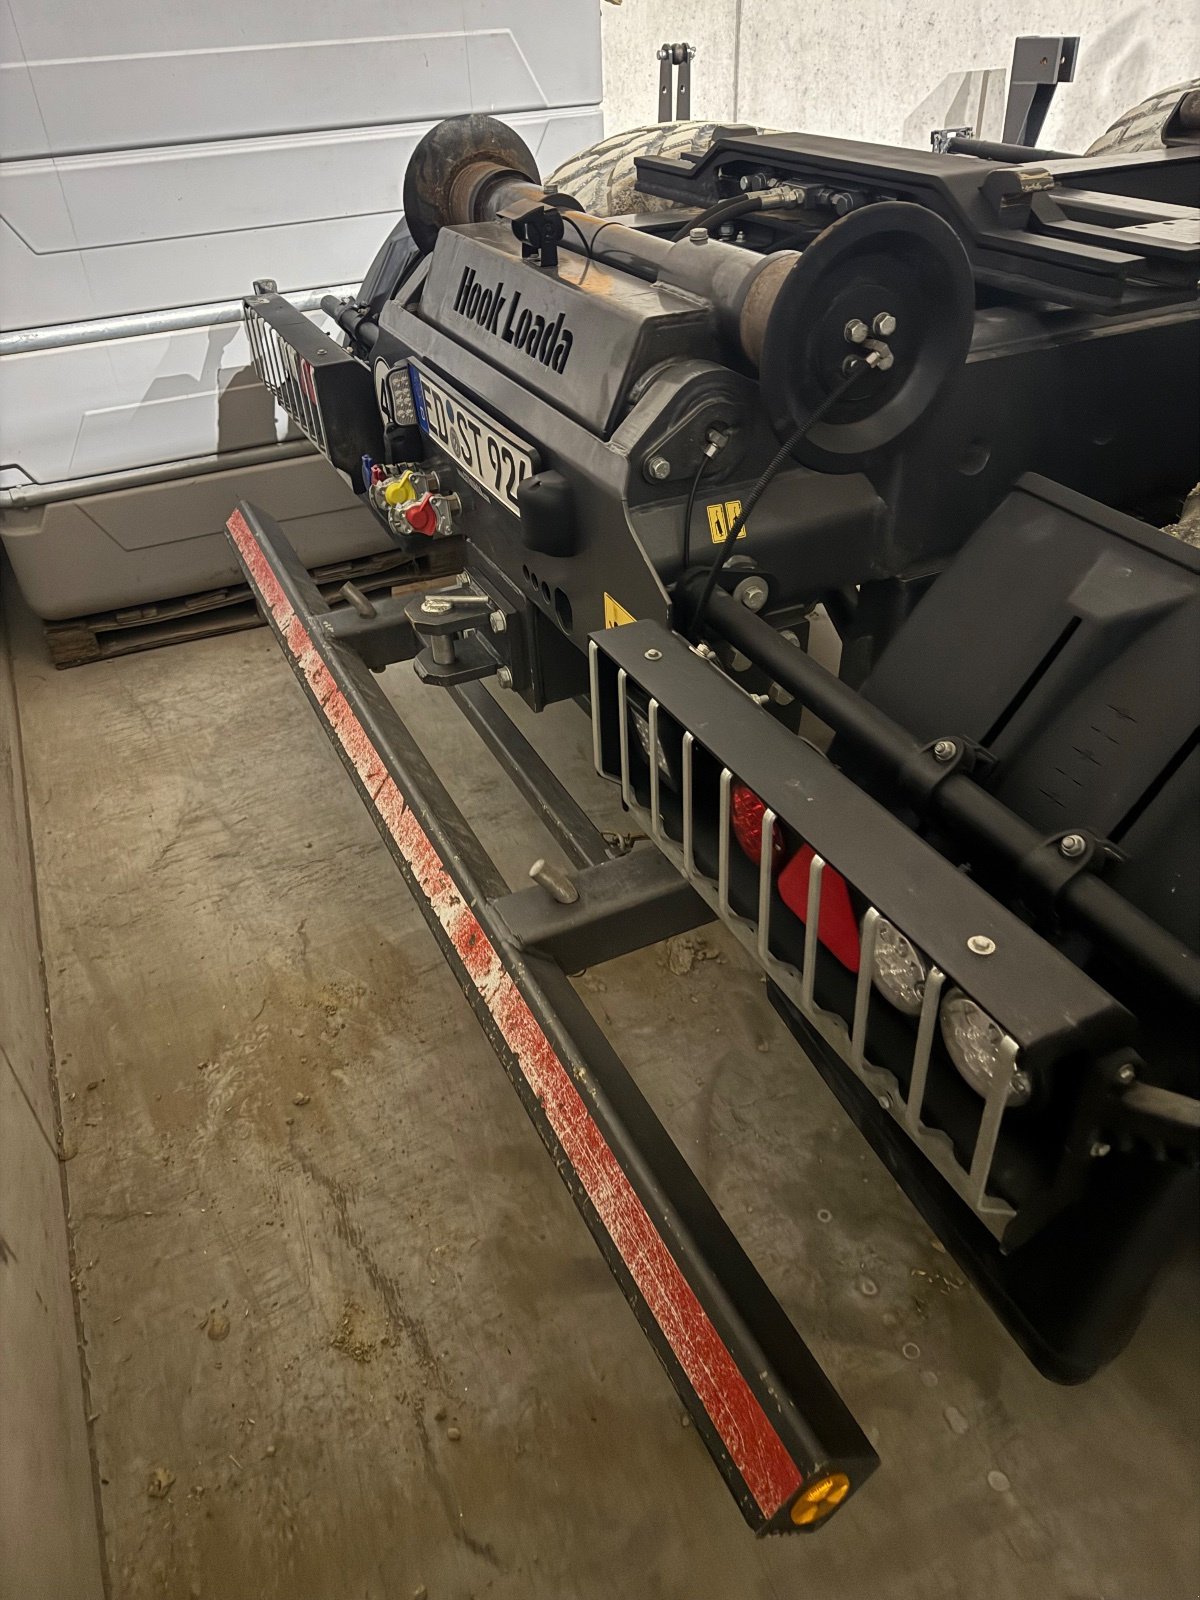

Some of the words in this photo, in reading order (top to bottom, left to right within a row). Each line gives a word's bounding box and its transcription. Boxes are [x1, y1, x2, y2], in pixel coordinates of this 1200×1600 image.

[453, 265, 506, 335] Hook
[501, 290, 574, 374] Loada
[420, 379, 449, 445] ED
[456, 410, 484, 478] ST
